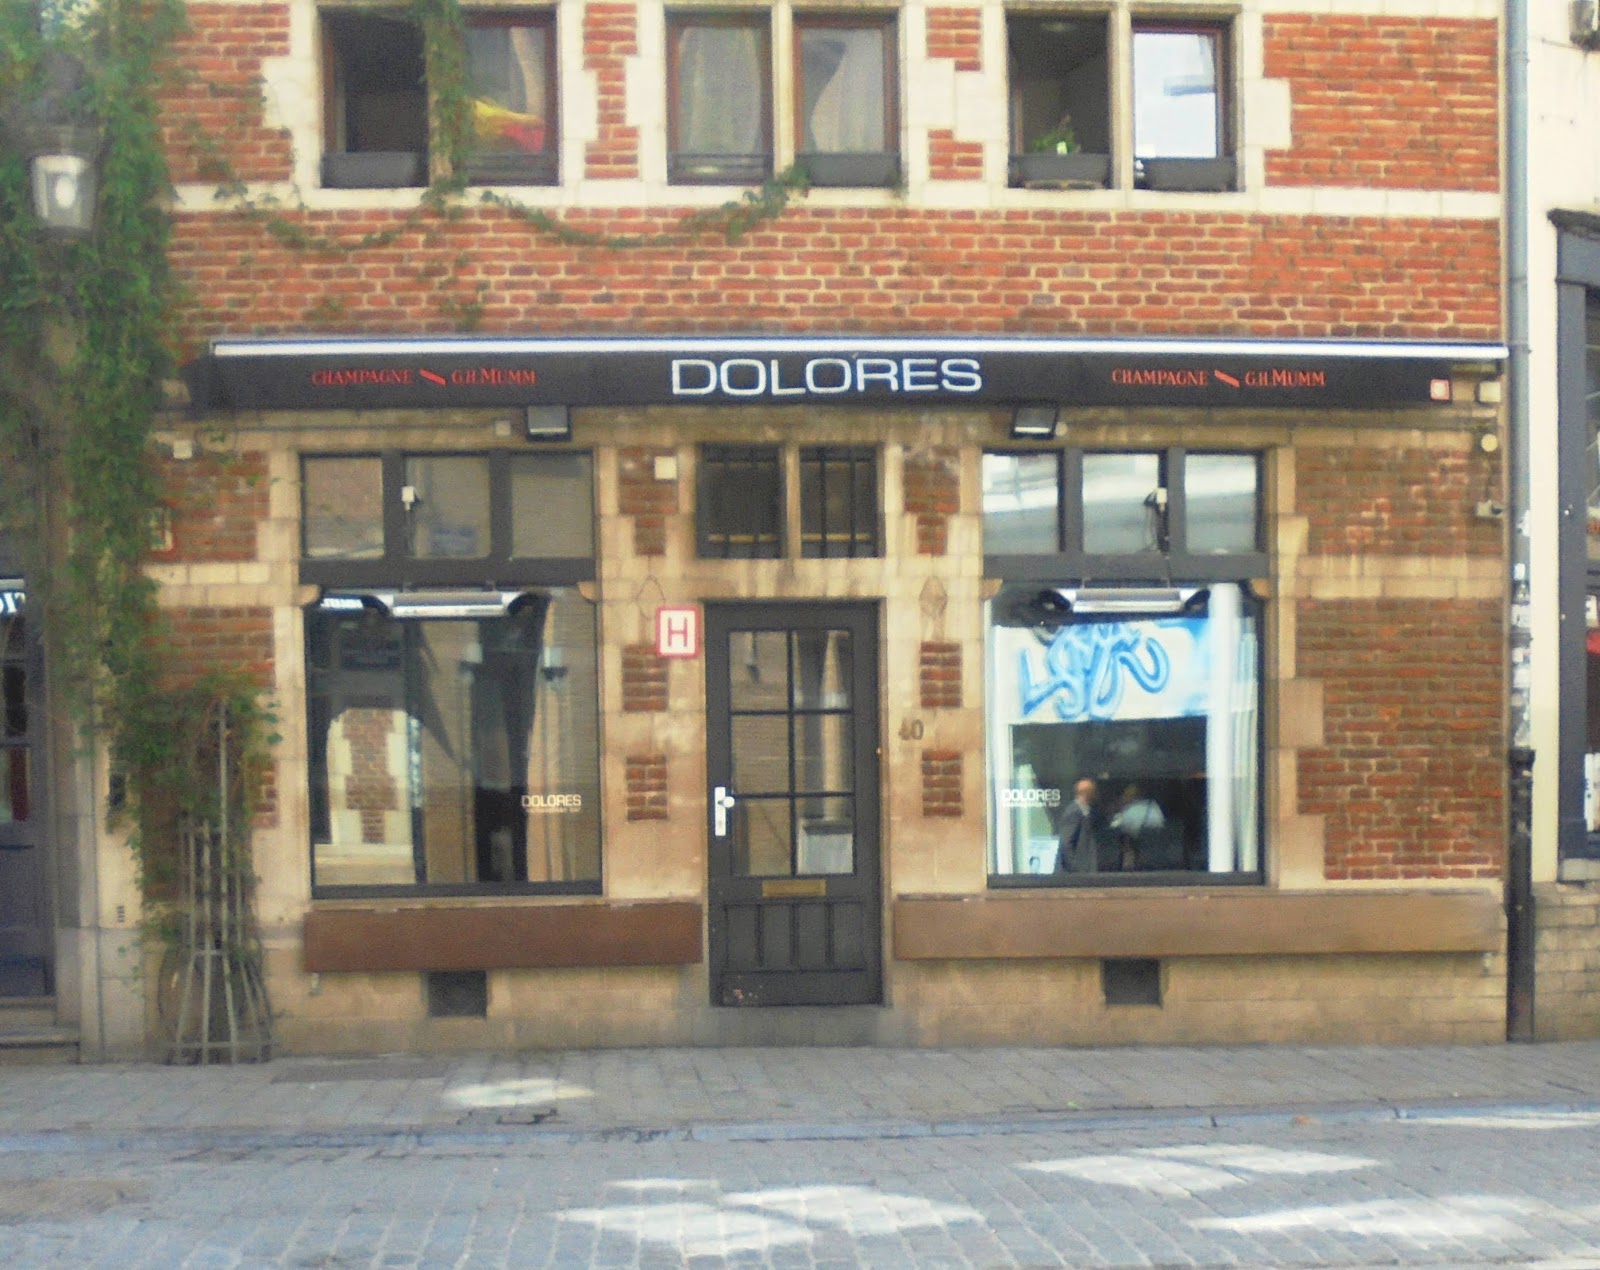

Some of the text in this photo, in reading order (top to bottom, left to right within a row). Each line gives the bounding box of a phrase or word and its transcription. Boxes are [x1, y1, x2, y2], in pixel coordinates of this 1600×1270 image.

[311, 369, 414, 385] CHAMPAGNE
[671, 358, 983, 396] DOLORES
[1111, 368, 1208, 386] CHAMPAGNE
[667, 617, 688, 647] H
[521, 794, 582, 807] DOLORES
[1001, 788, 1061, 801] DOLORES
